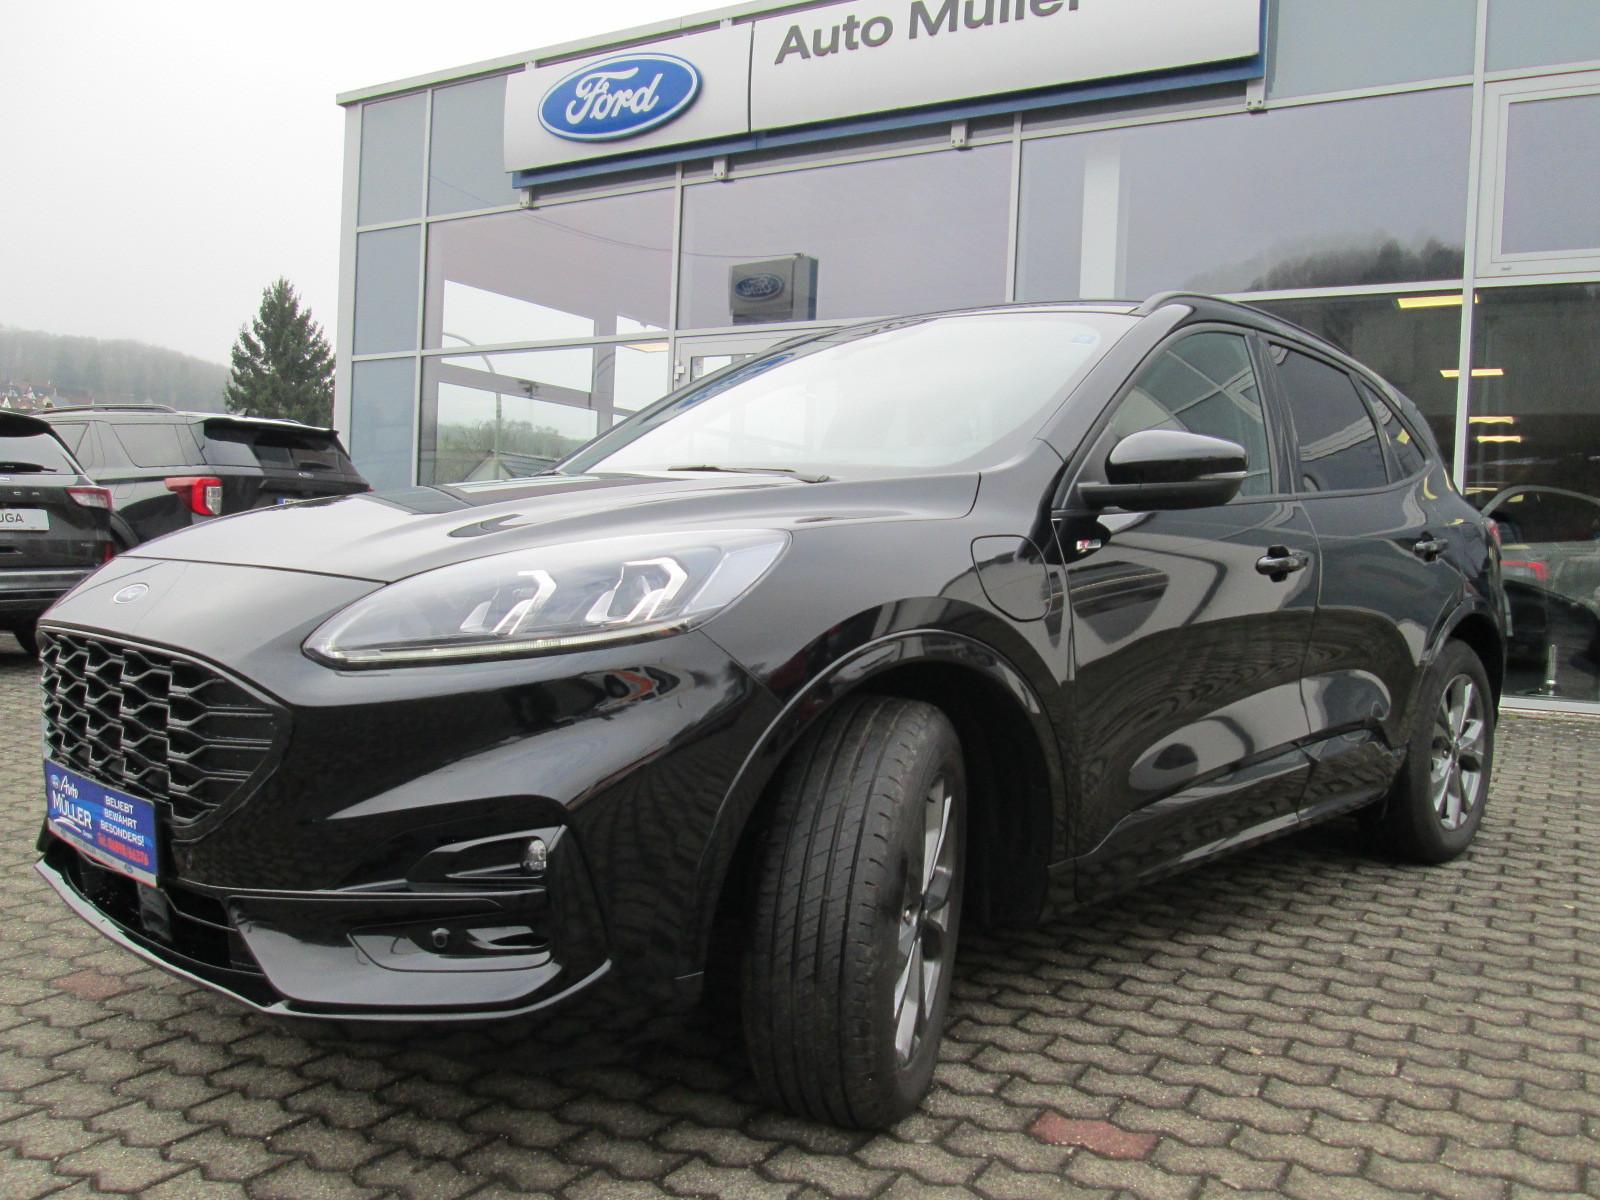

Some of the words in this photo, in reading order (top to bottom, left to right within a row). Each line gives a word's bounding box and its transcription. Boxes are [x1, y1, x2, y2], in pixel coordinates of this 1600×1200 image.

[774, 15, 894, 65] Auto
[565, 66, 664, 126] Ford
[60, 775, 79, 799] Auto
[52, 790, 92, 830] MÜLLER
[103, 807, 138, 830] BEWÄHRT
[105, 795, 134, 815] BELIEBT
[100, 819, 145, 847] BESONDERS!
